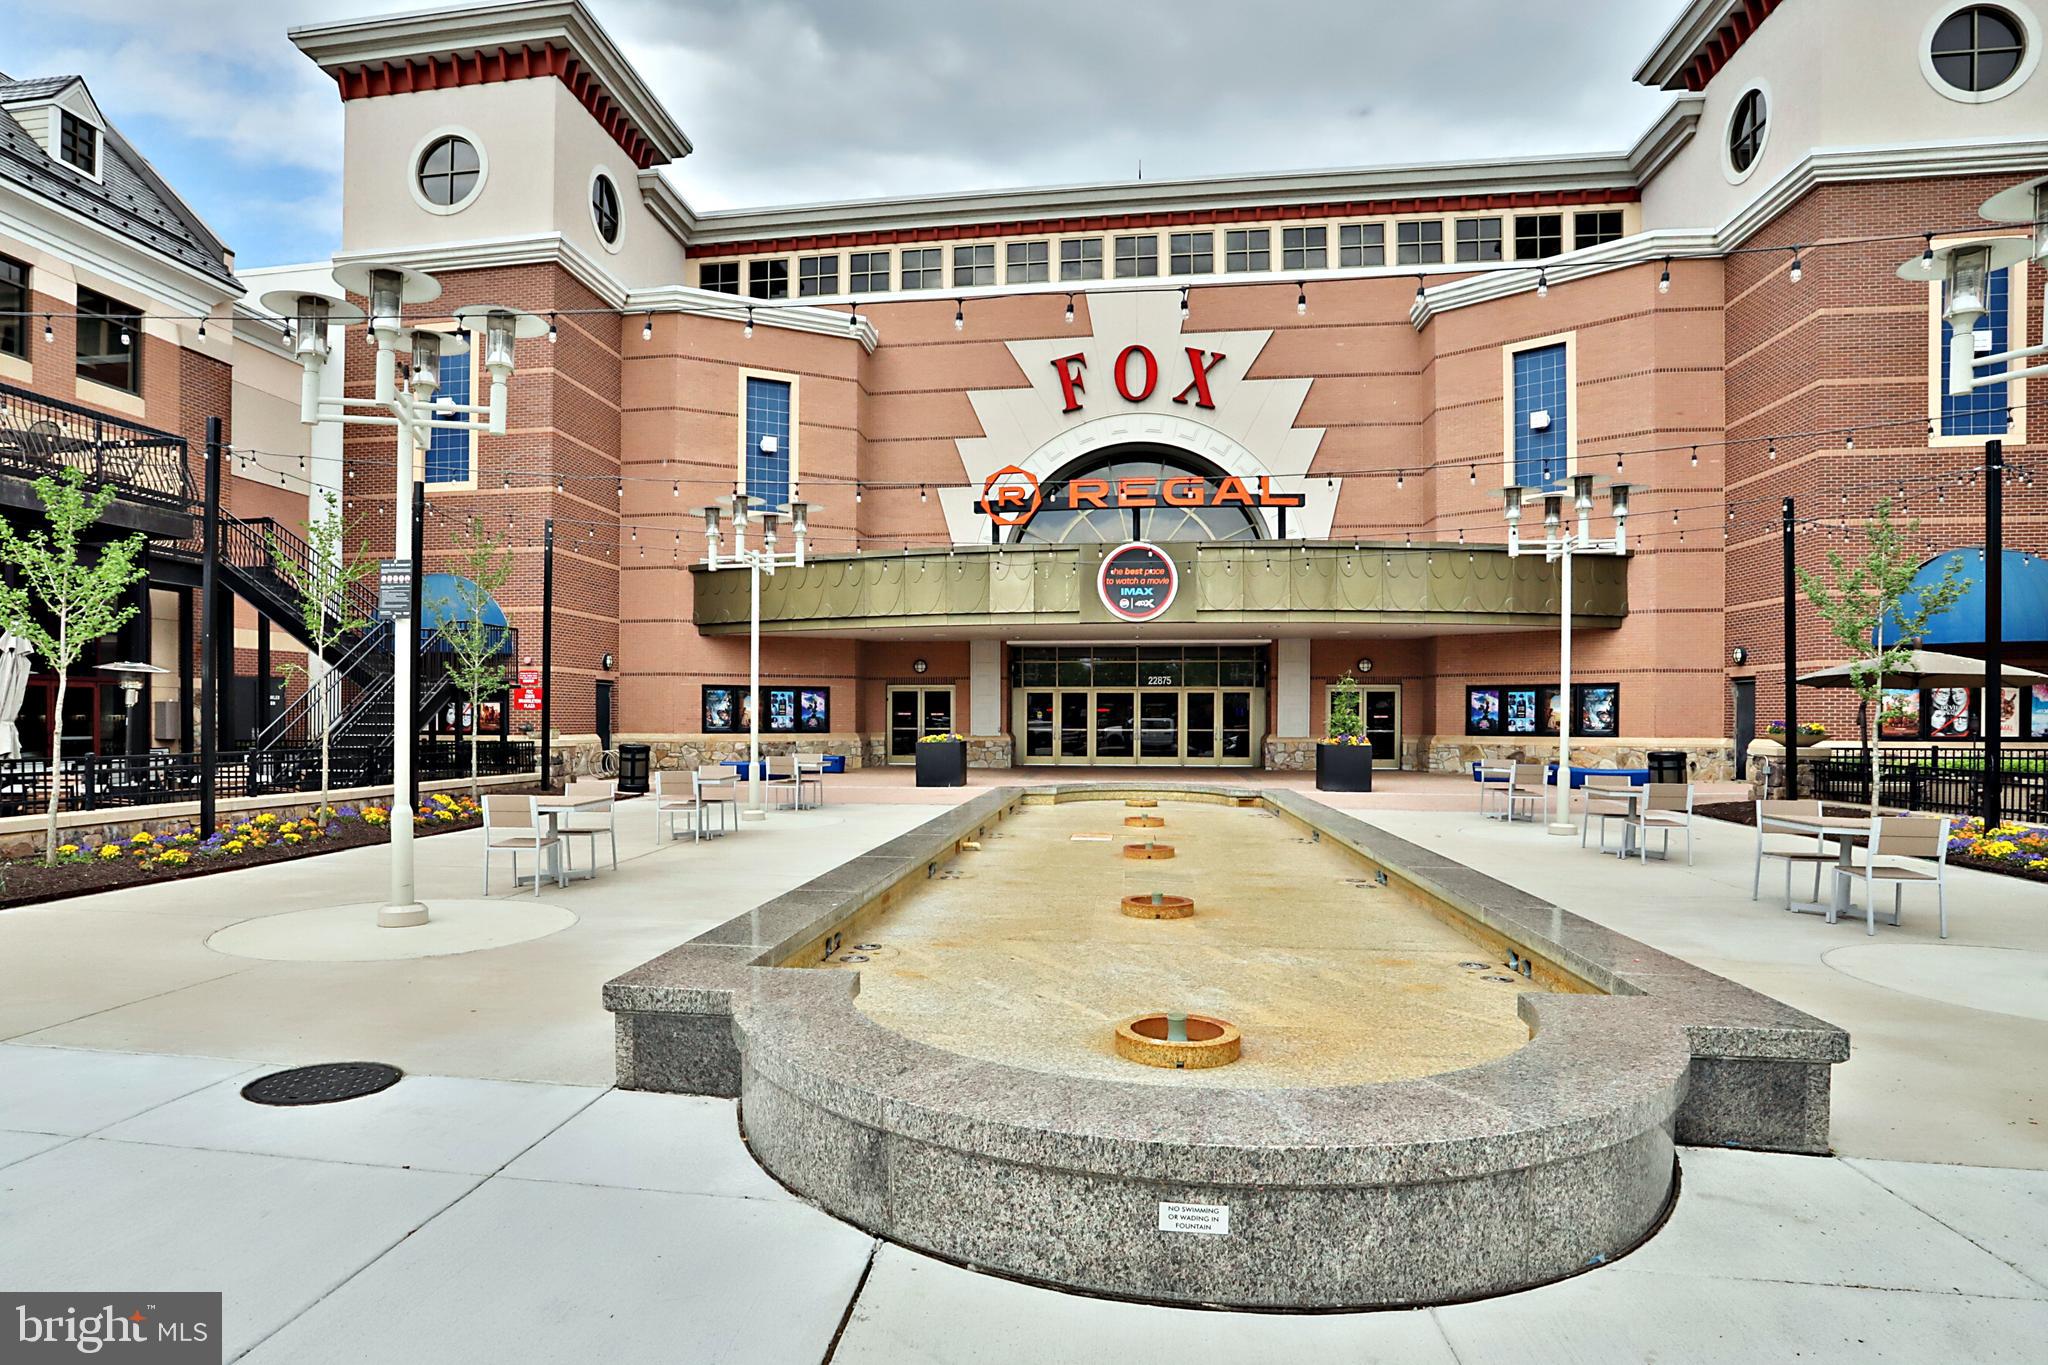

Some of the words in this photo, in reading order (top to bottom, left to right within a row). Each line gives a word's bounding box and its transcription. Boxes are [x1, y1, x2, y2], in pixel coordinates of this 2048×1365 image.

[1050, 344, 1227, 414] FOX
[1069, 475, 1300, 509] REGAL
[1124, 567, 1143, 575] best
[1120, 587, 1153, 596] IMAX
[1148, 676, 1172, 685] 22875
[1168, 1205, 1180, 1213] NO
[1182, 1206, 1220, 1214] SWIMMING
[1168, 1213, 1178, 1221] OR
[1180, 1214, 1209, 1222] WADING
[1175, 1222, 1212, 1231] FOUNTAIN
